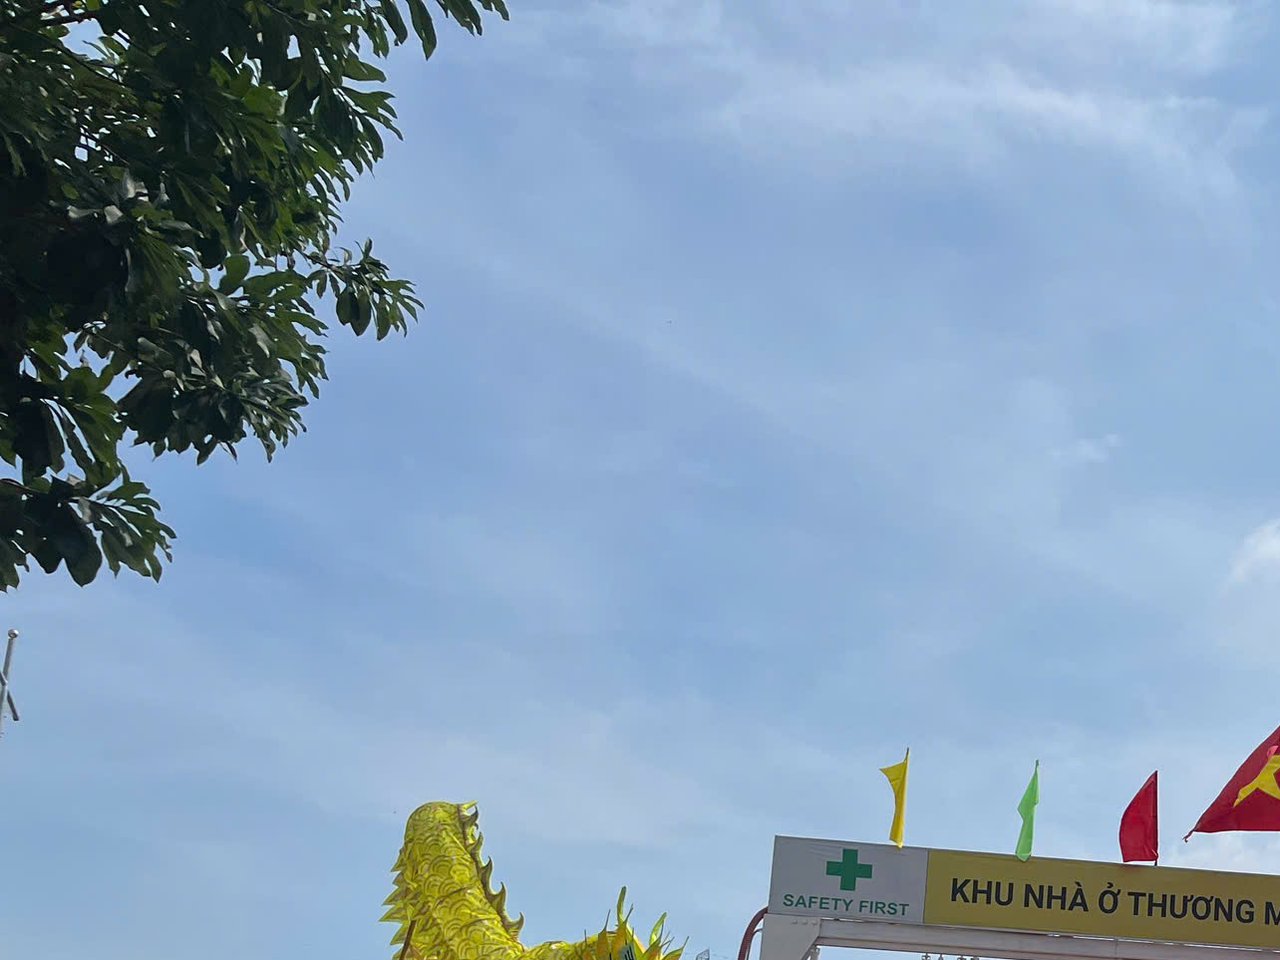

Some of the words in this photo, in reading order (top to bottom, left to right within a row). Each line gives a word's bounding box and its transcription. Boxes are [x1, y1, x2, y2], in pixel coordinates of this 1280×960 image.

[783, 893, 851, 912] SAFETY
[858, 898, 909, 917] FIRST
[950, 877, 1014, 907] KHU
[1024, 880, 1089, 914] NHÀ
[1098, 882, 1122, 915] Ở
[1127, 891, 1256, 924] THƯƠNG
